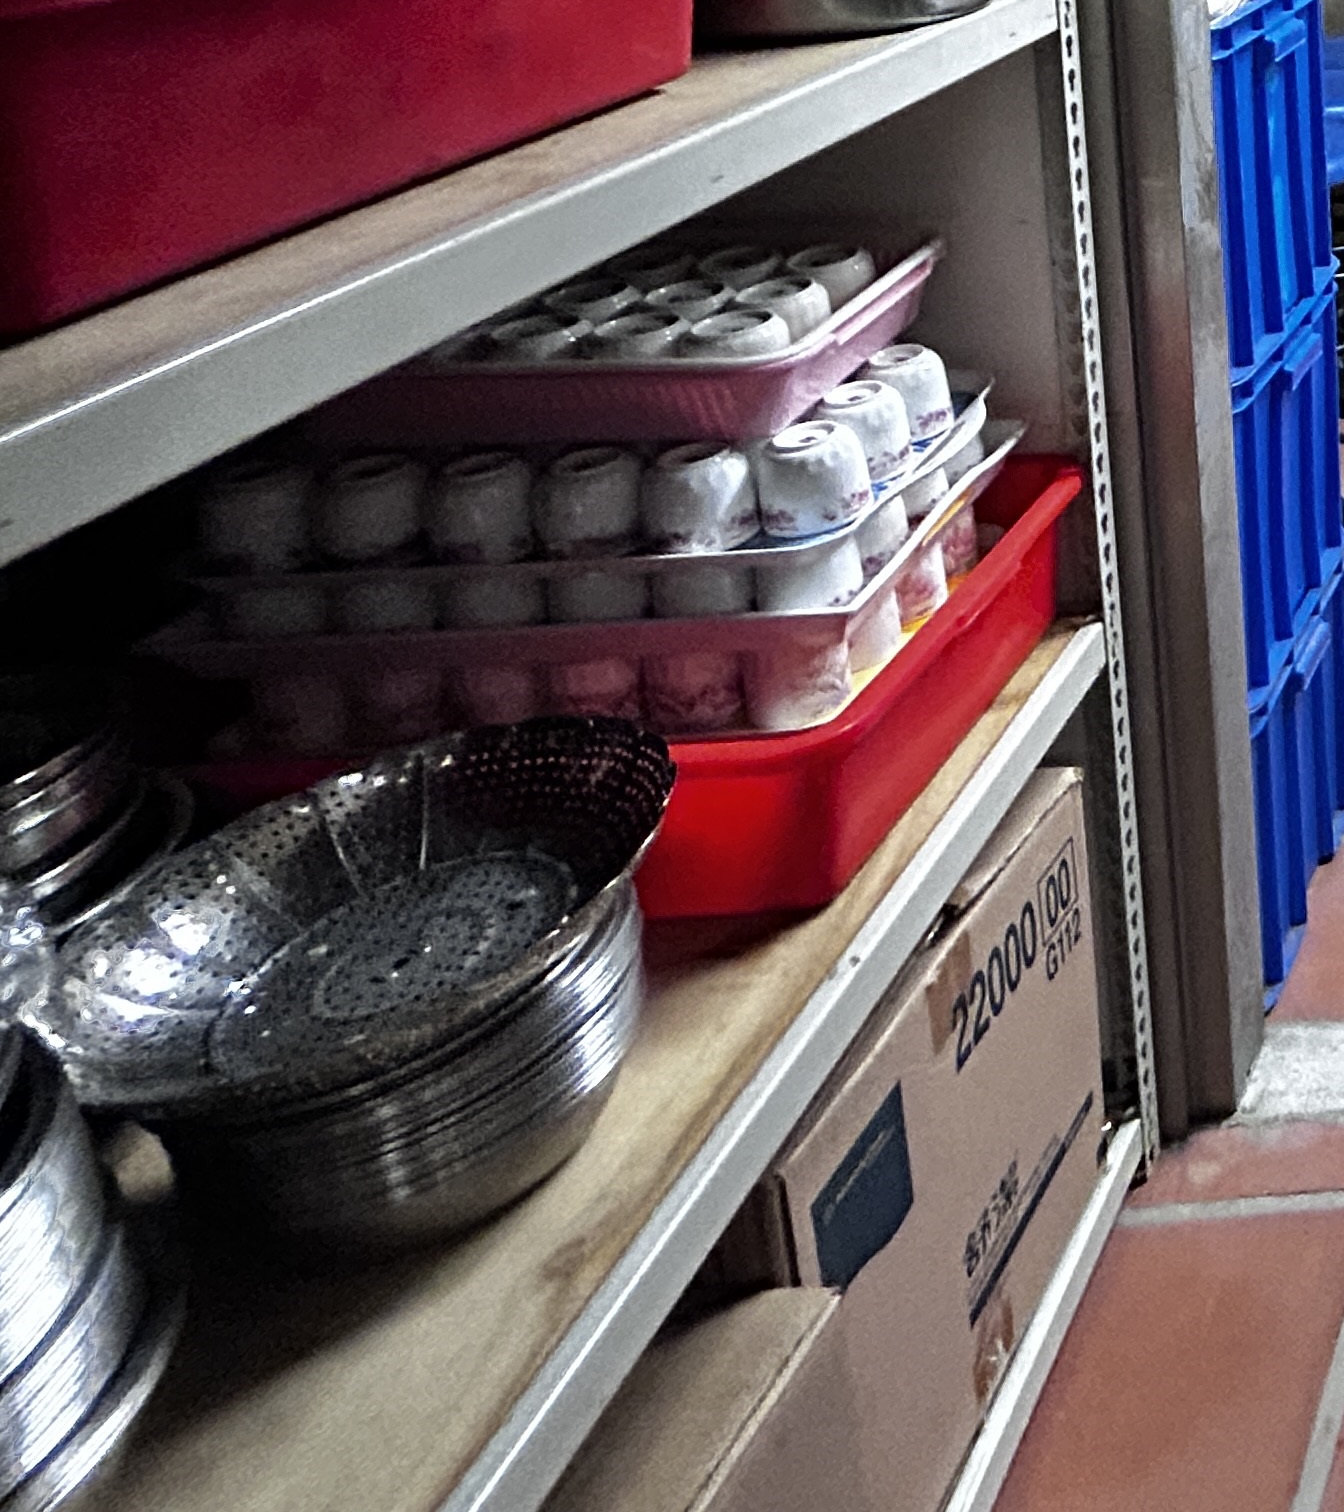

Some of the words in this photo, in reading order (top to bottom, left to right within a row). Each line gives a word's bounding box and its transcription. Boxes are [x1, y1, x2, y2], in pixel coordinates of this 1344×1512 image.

[952, 900, 1037, 1074] 22000
[1046, 858, 1071, 928] 00
[1046, 907, 1082, 981] G112
